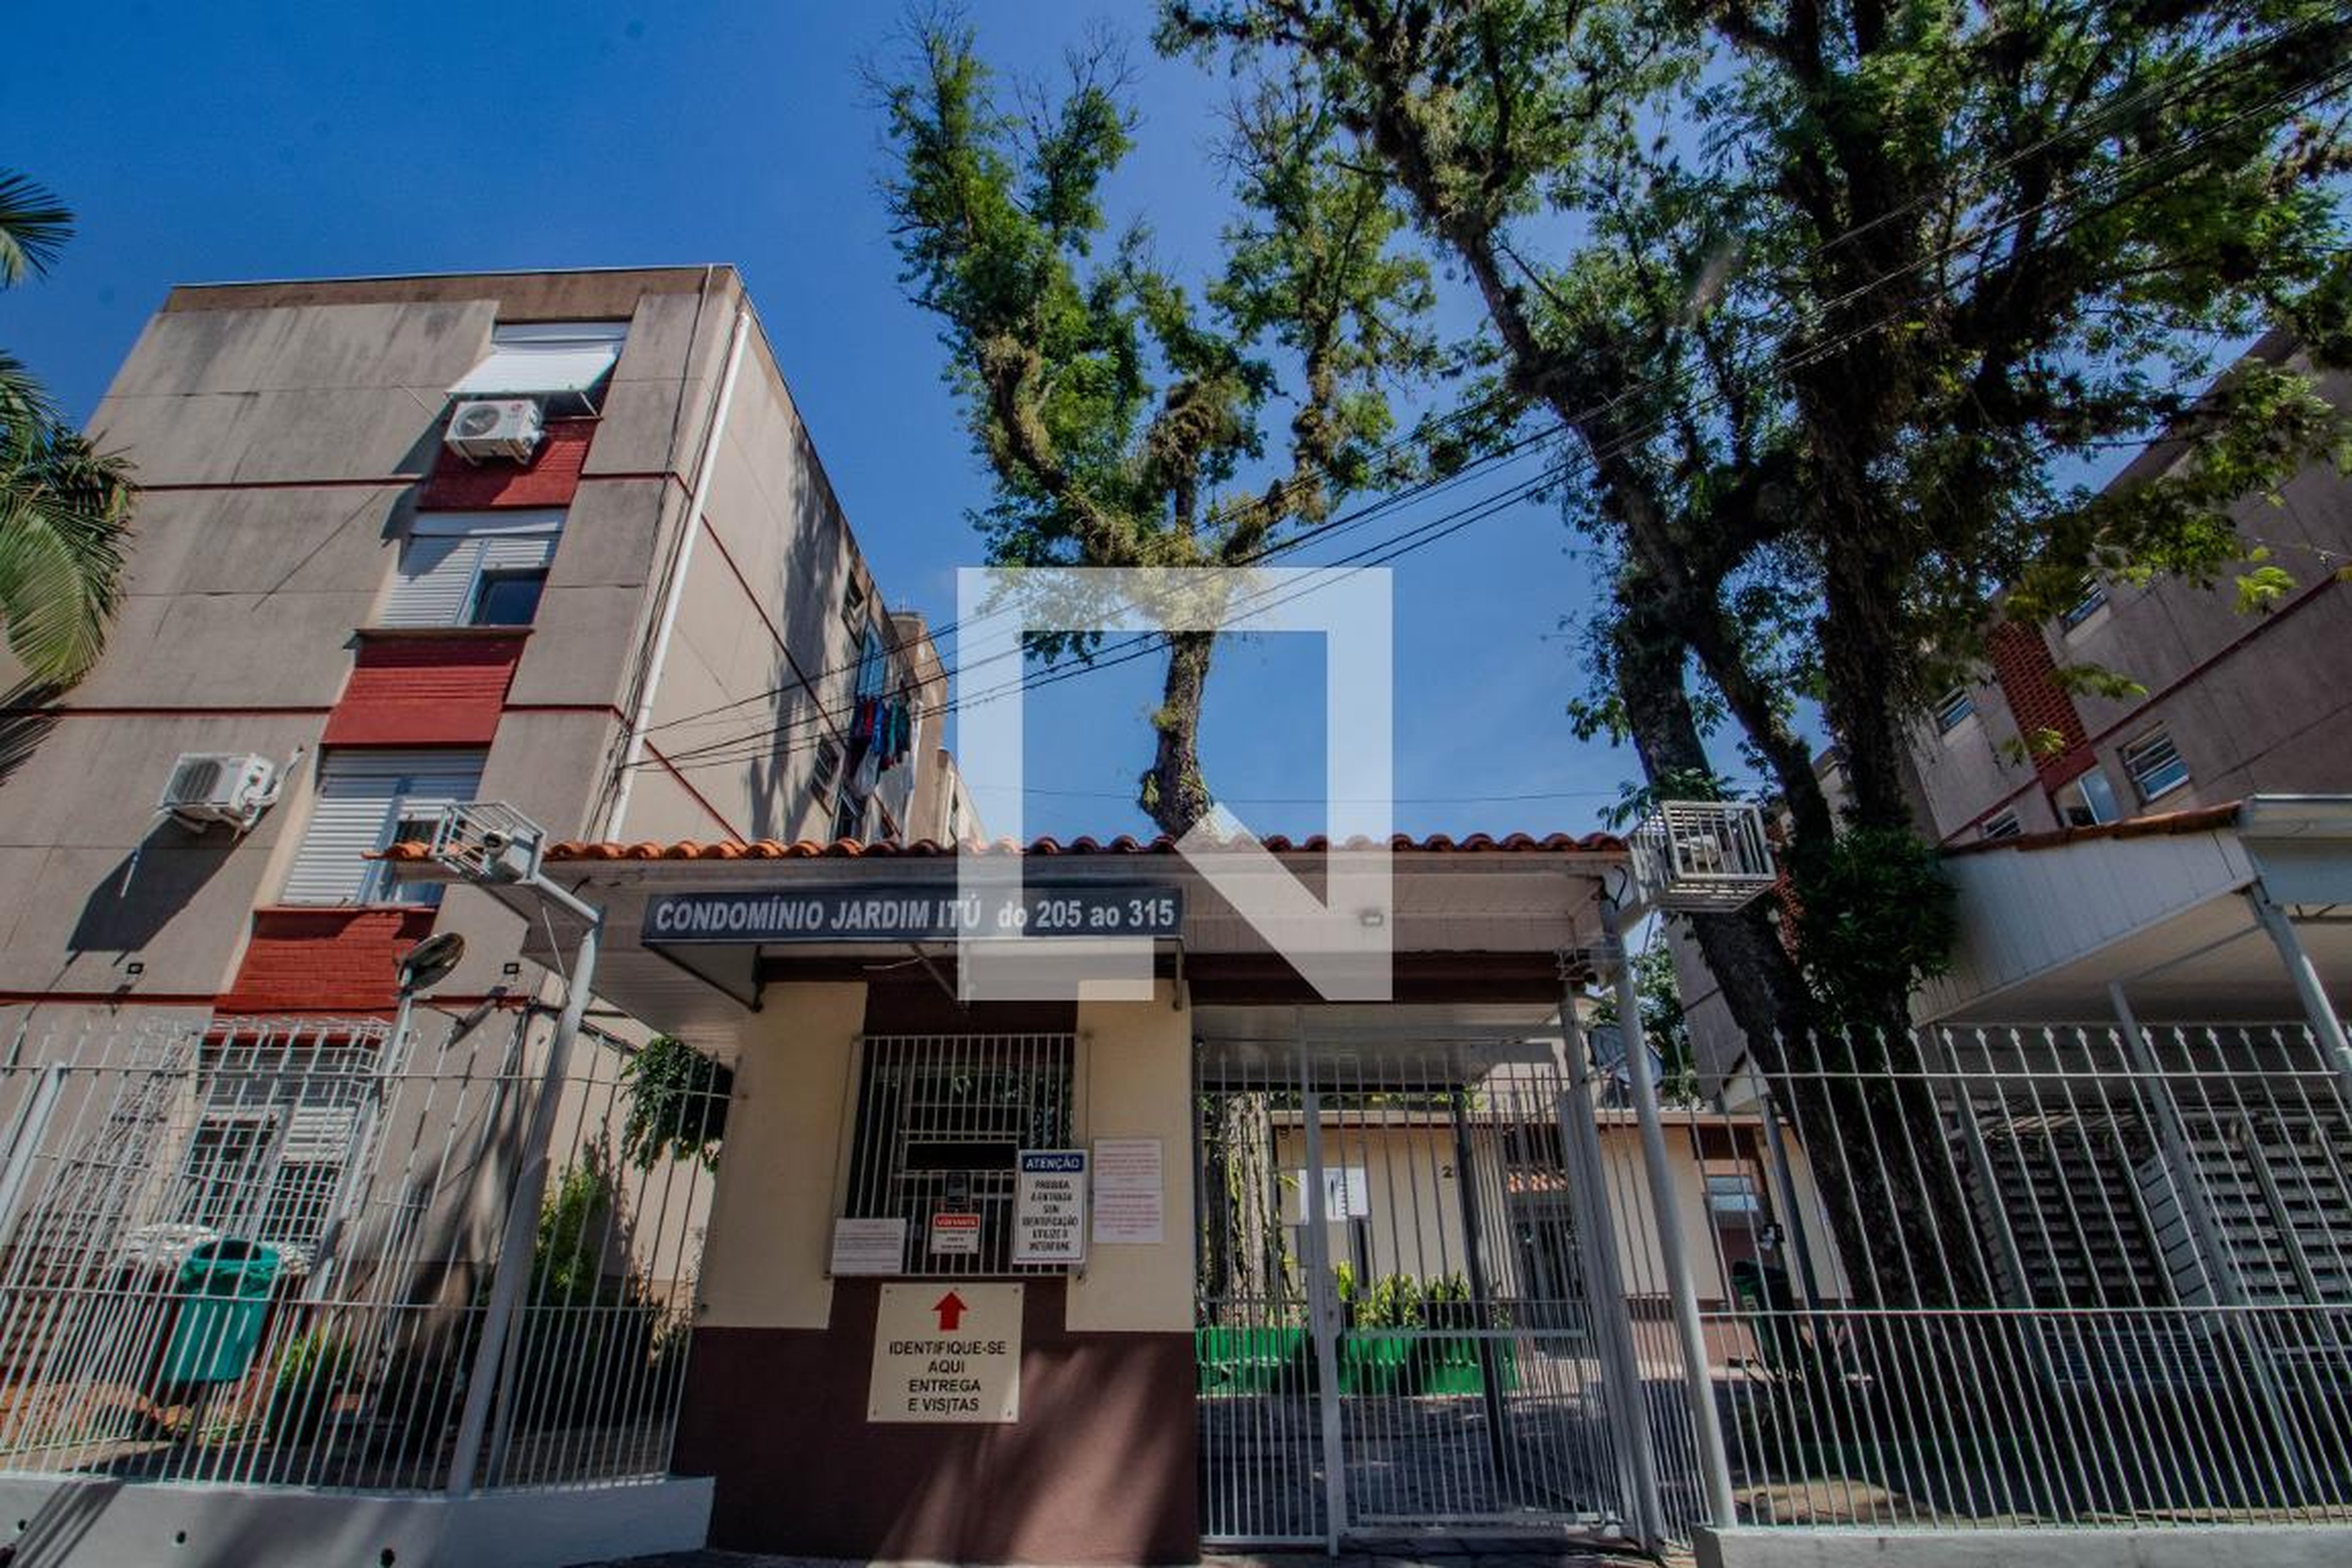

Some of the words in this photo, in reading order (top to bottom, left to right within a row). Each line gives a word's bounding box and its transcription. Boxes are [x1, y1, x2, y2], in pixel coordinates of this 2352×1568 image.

[656, 895, 824, 930] CONDOMÍNIO
[830, 900, 930, 930] JARDIM
[937, 893, 981, 929] ITÚ
[1035, 900, 1083, 928] 205
[1090, 909, 1120, 927] ao
[1128, 899, 1175, 927] 315
[1025, 1156, 1080, 1170] ATENÇÃO
[1442, 1165, 1453, 1178] 2
[889, 1341, 1007, 1355] IDENTIFIQUE-SE
[928, 1360, 965, 1374] AQUI
[909, 1379, 981, 1392] ENTREGA
[908, 1398, 918, 1412] E
[922, 1398, 980, 1413] VISITAS
